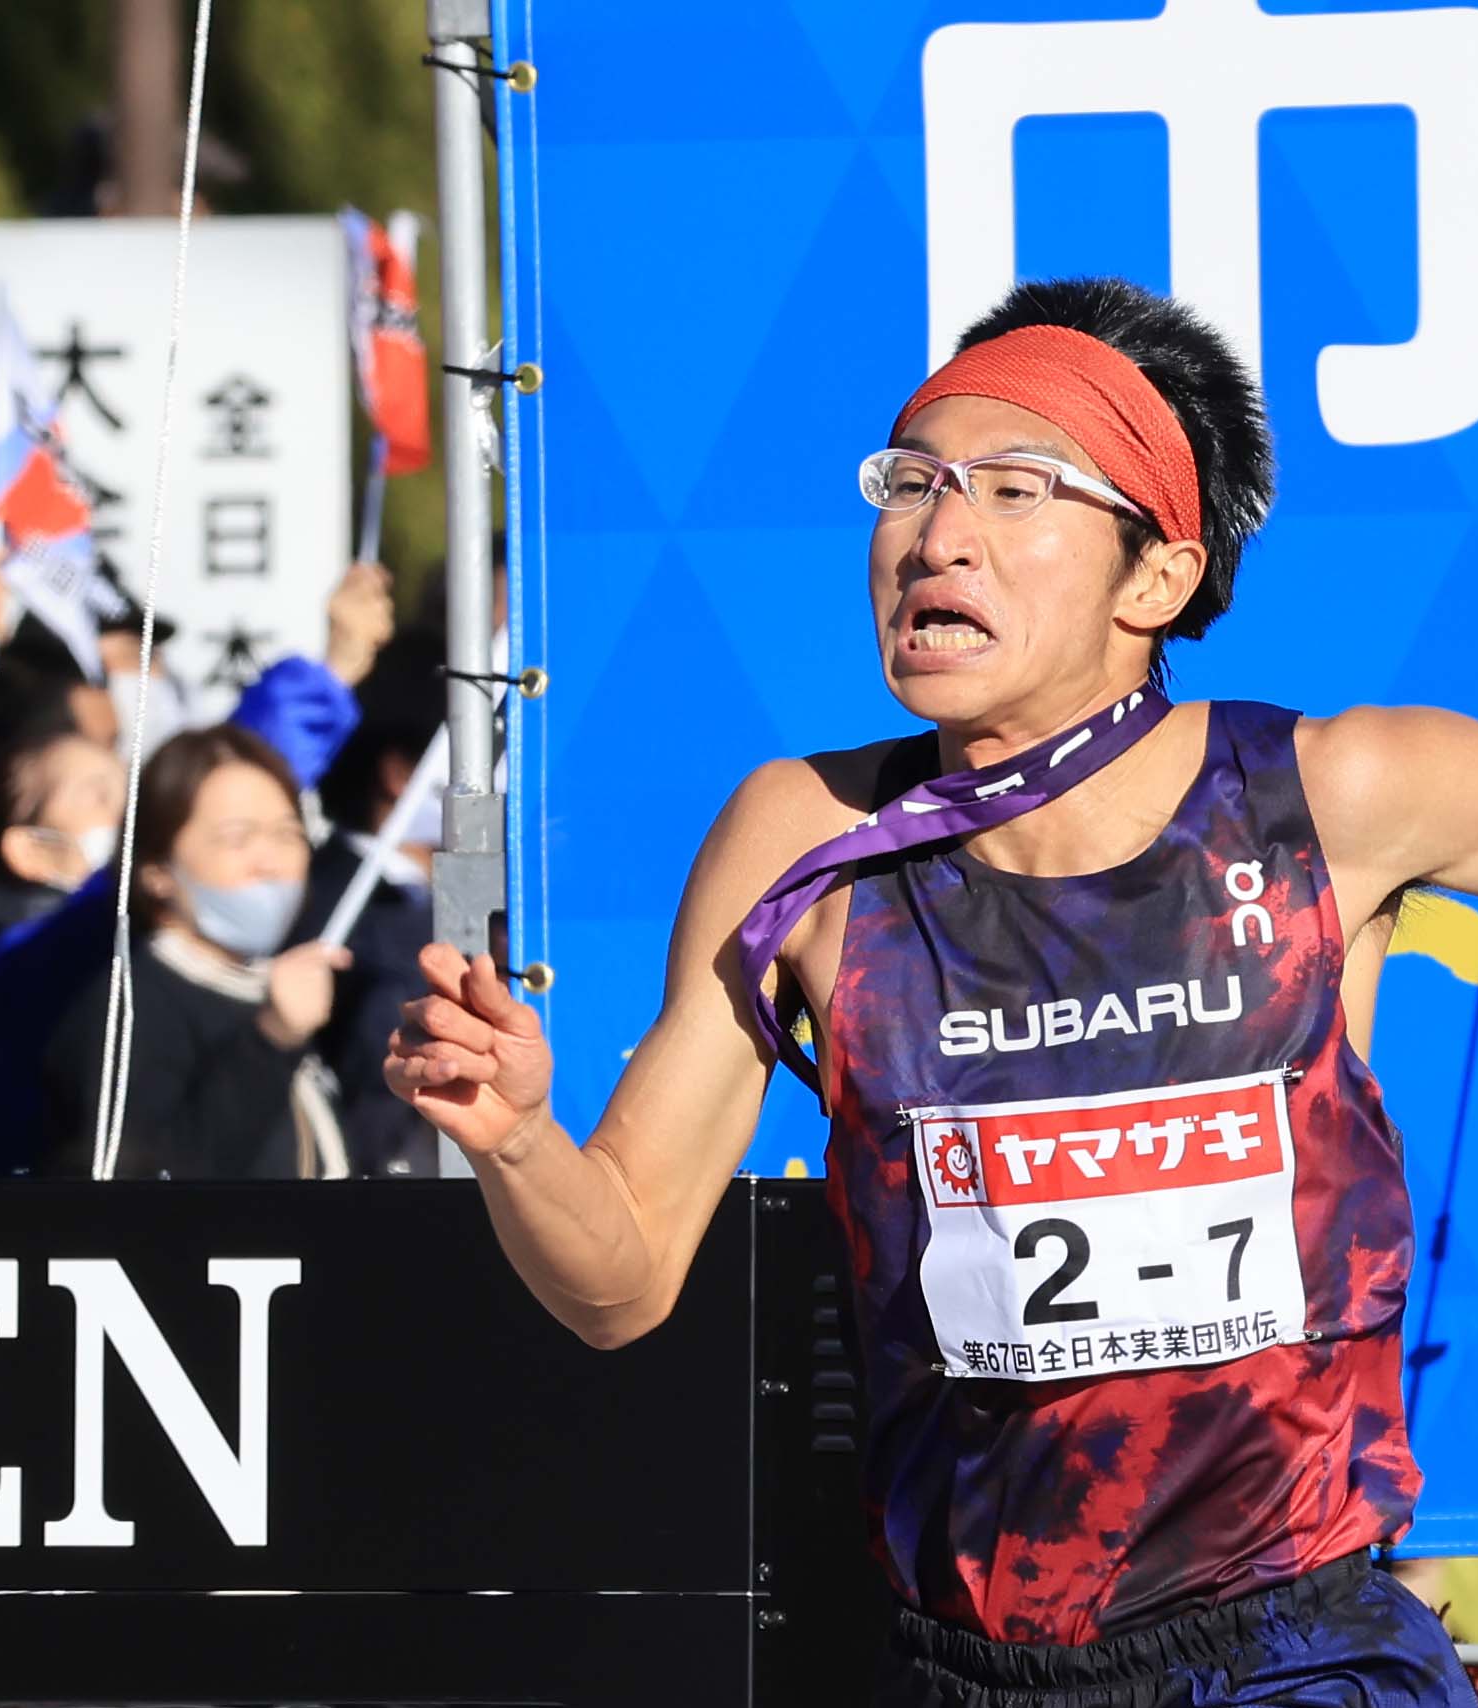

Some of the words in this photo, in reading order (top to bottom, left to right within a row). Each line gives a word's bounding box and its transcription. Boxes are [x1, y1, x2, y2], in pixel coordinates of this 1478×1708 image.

[939, 975, 1243, 1056] SUBARU
[994, 1110, 1263, 1186] ヤマザキ
[962, 1310, 1278, 1375] 第67回全日本実業団駅伝
